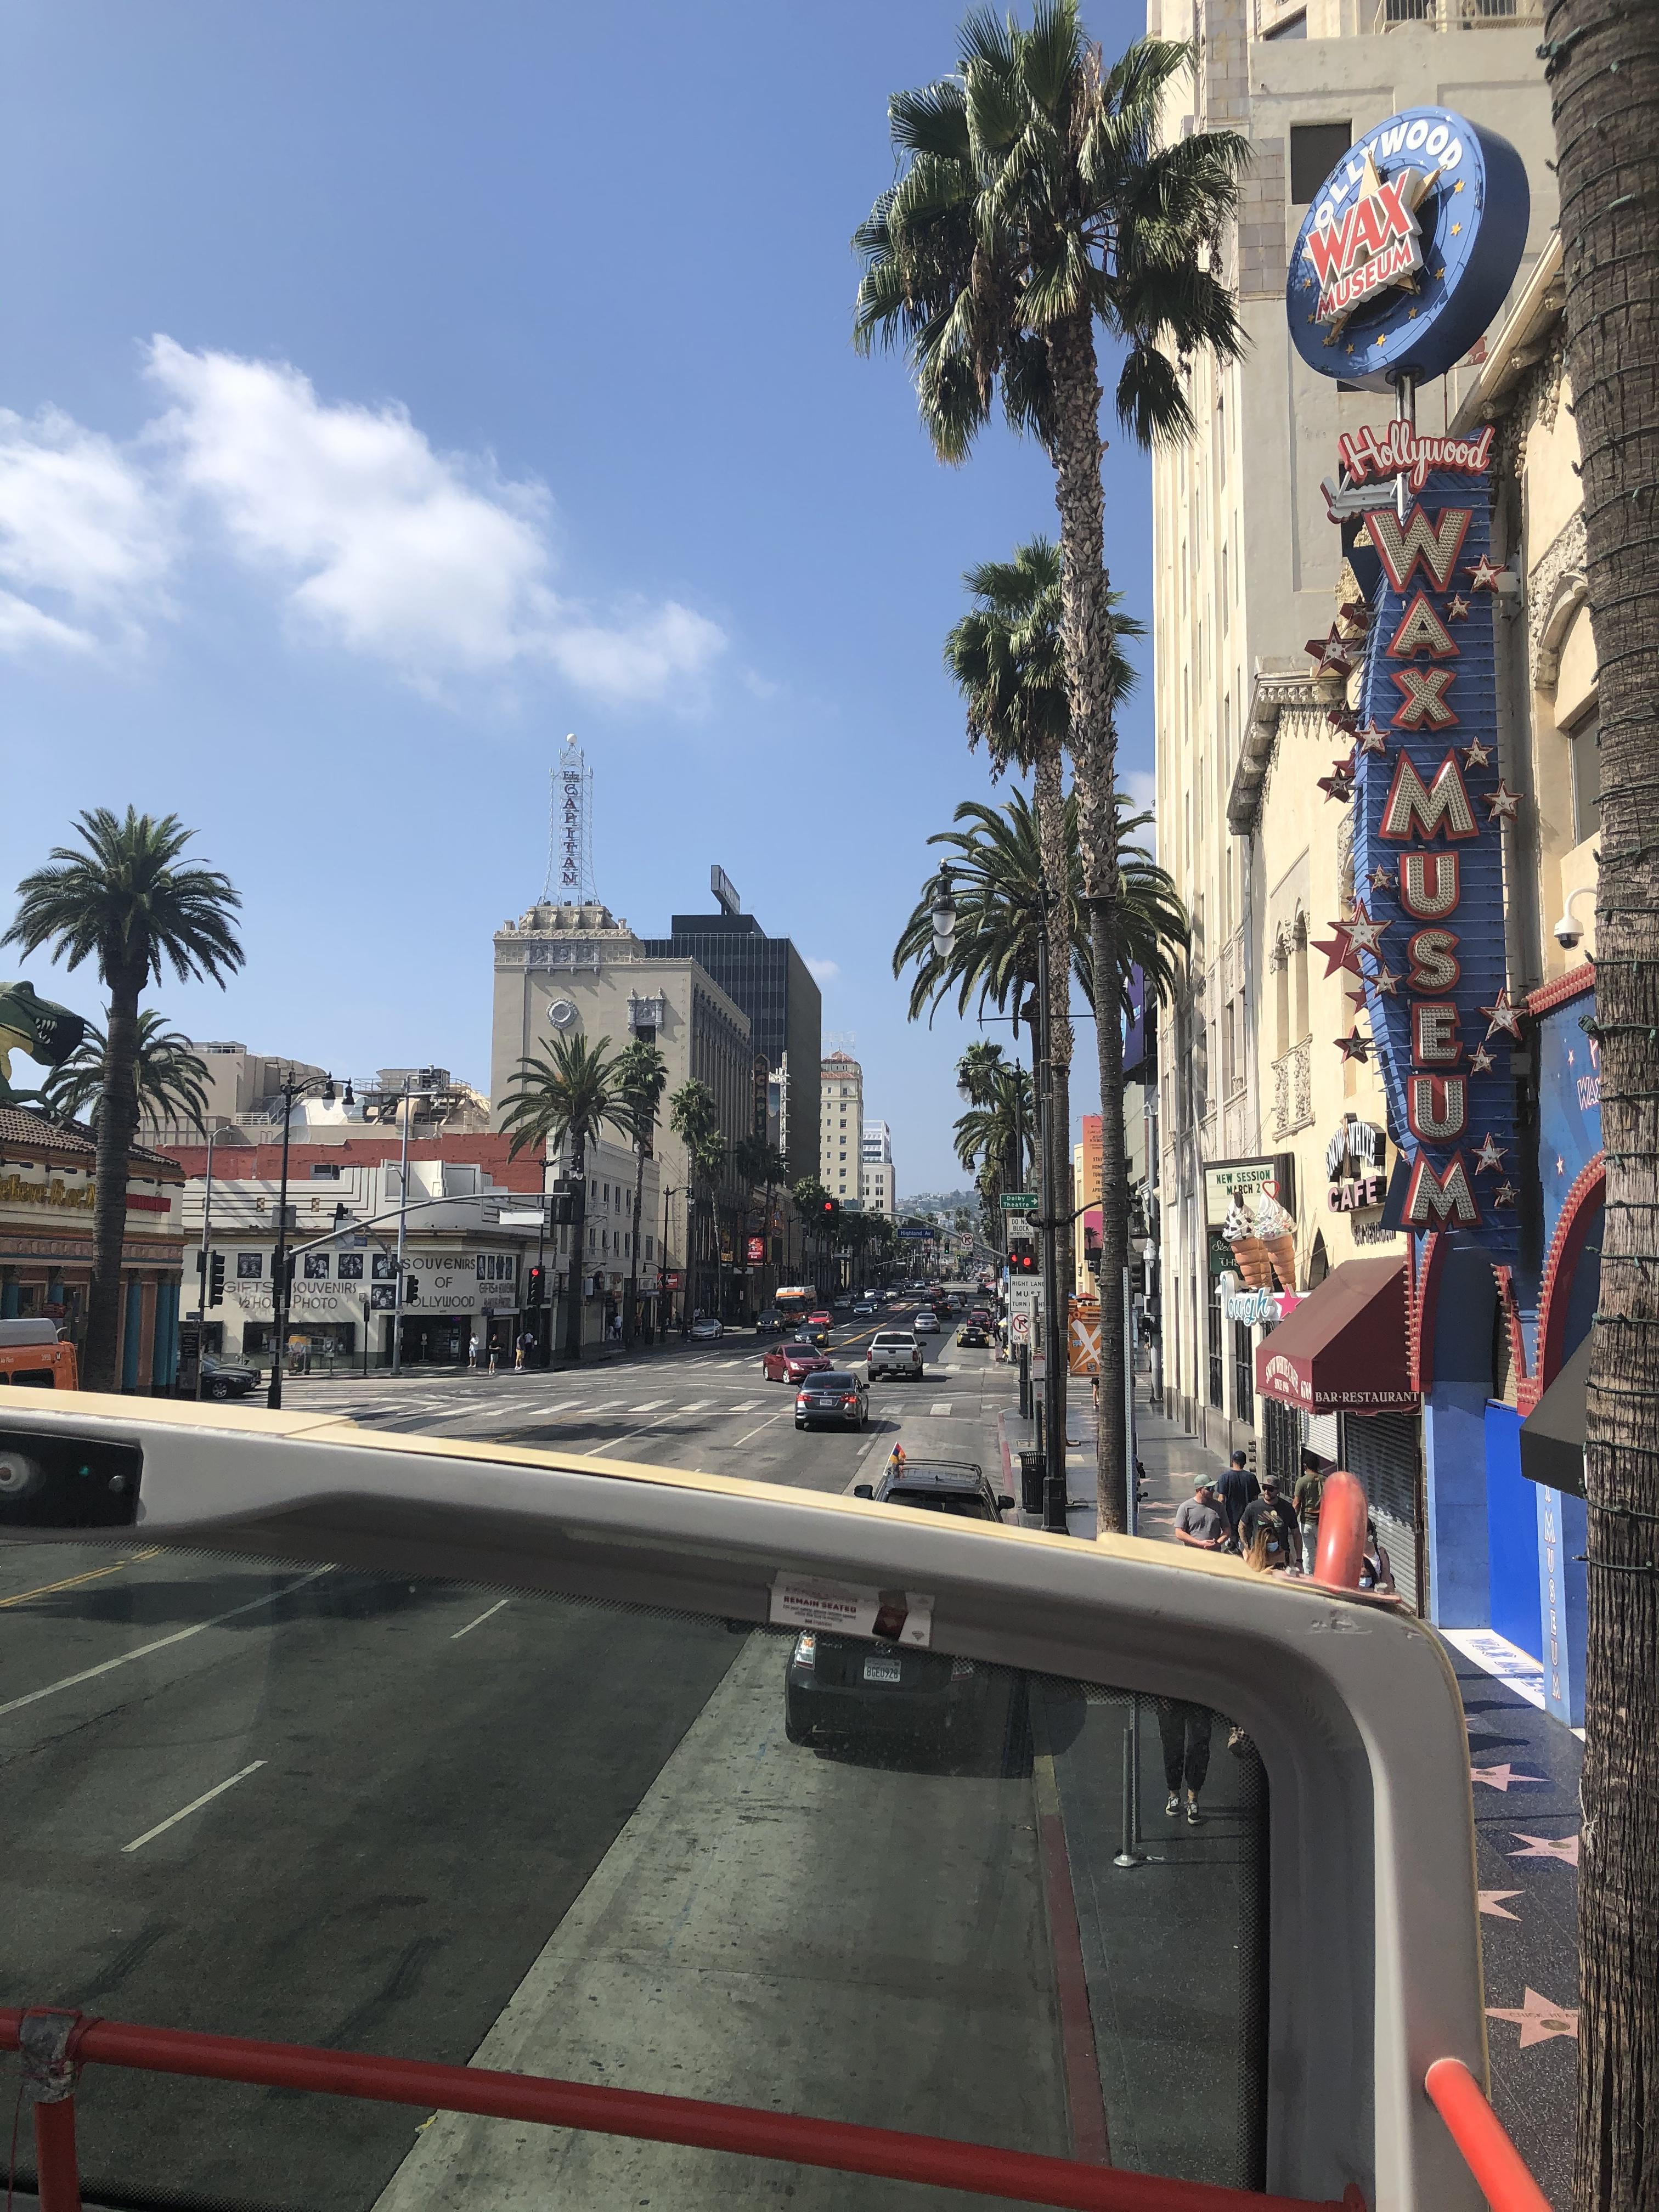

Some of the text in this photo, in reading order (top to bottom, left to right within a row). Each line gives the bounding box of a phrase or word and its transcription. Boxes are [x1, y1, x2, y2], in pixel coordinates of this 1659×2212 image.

[1314, 119, 1463, 229] OLLYWOOD
[1306, 168, 1413, 294] WAX
[1315, 233, 1414, 324] MUSEUM
[1340, 420, 1495, 492] Hollywood
[1366, 506, 1470, 727] WAX
[562, 783, 578, 885] CAPITAN
[1380, 749, 1482, 1229] MUSEUM
[1325, 1121, 1375, 1182] SNOW WHITE
[0, 1174, 47, 1203] elieve
[1216, 1170, 1270, 1184] NEW SESSION
[1227, 1184, 1253, 1195] MARCH
[1328, 1176, 1377, 1212] CAFE
[403, 1257, 476, 1270] SOUVENIRS
[223, 1281, 357, 1294] GIFTS SOUVENIRS
[435, 1276, 453, 1288] OF
[253, 1296, 272, 1309] HO
[294, 1294, 338, 1310] PHOTO
[407, 1295, 475, 1308] OLLYWOOD
[1266, 1356, 1299, 1394] SNOW WHITE CAFE
[1301, 1380, 1312, 1400] 6769
[783, 1595, 856, 1613] REMAIN SEATED
[1544, 1506, 1561, 1700] MUSEUM
